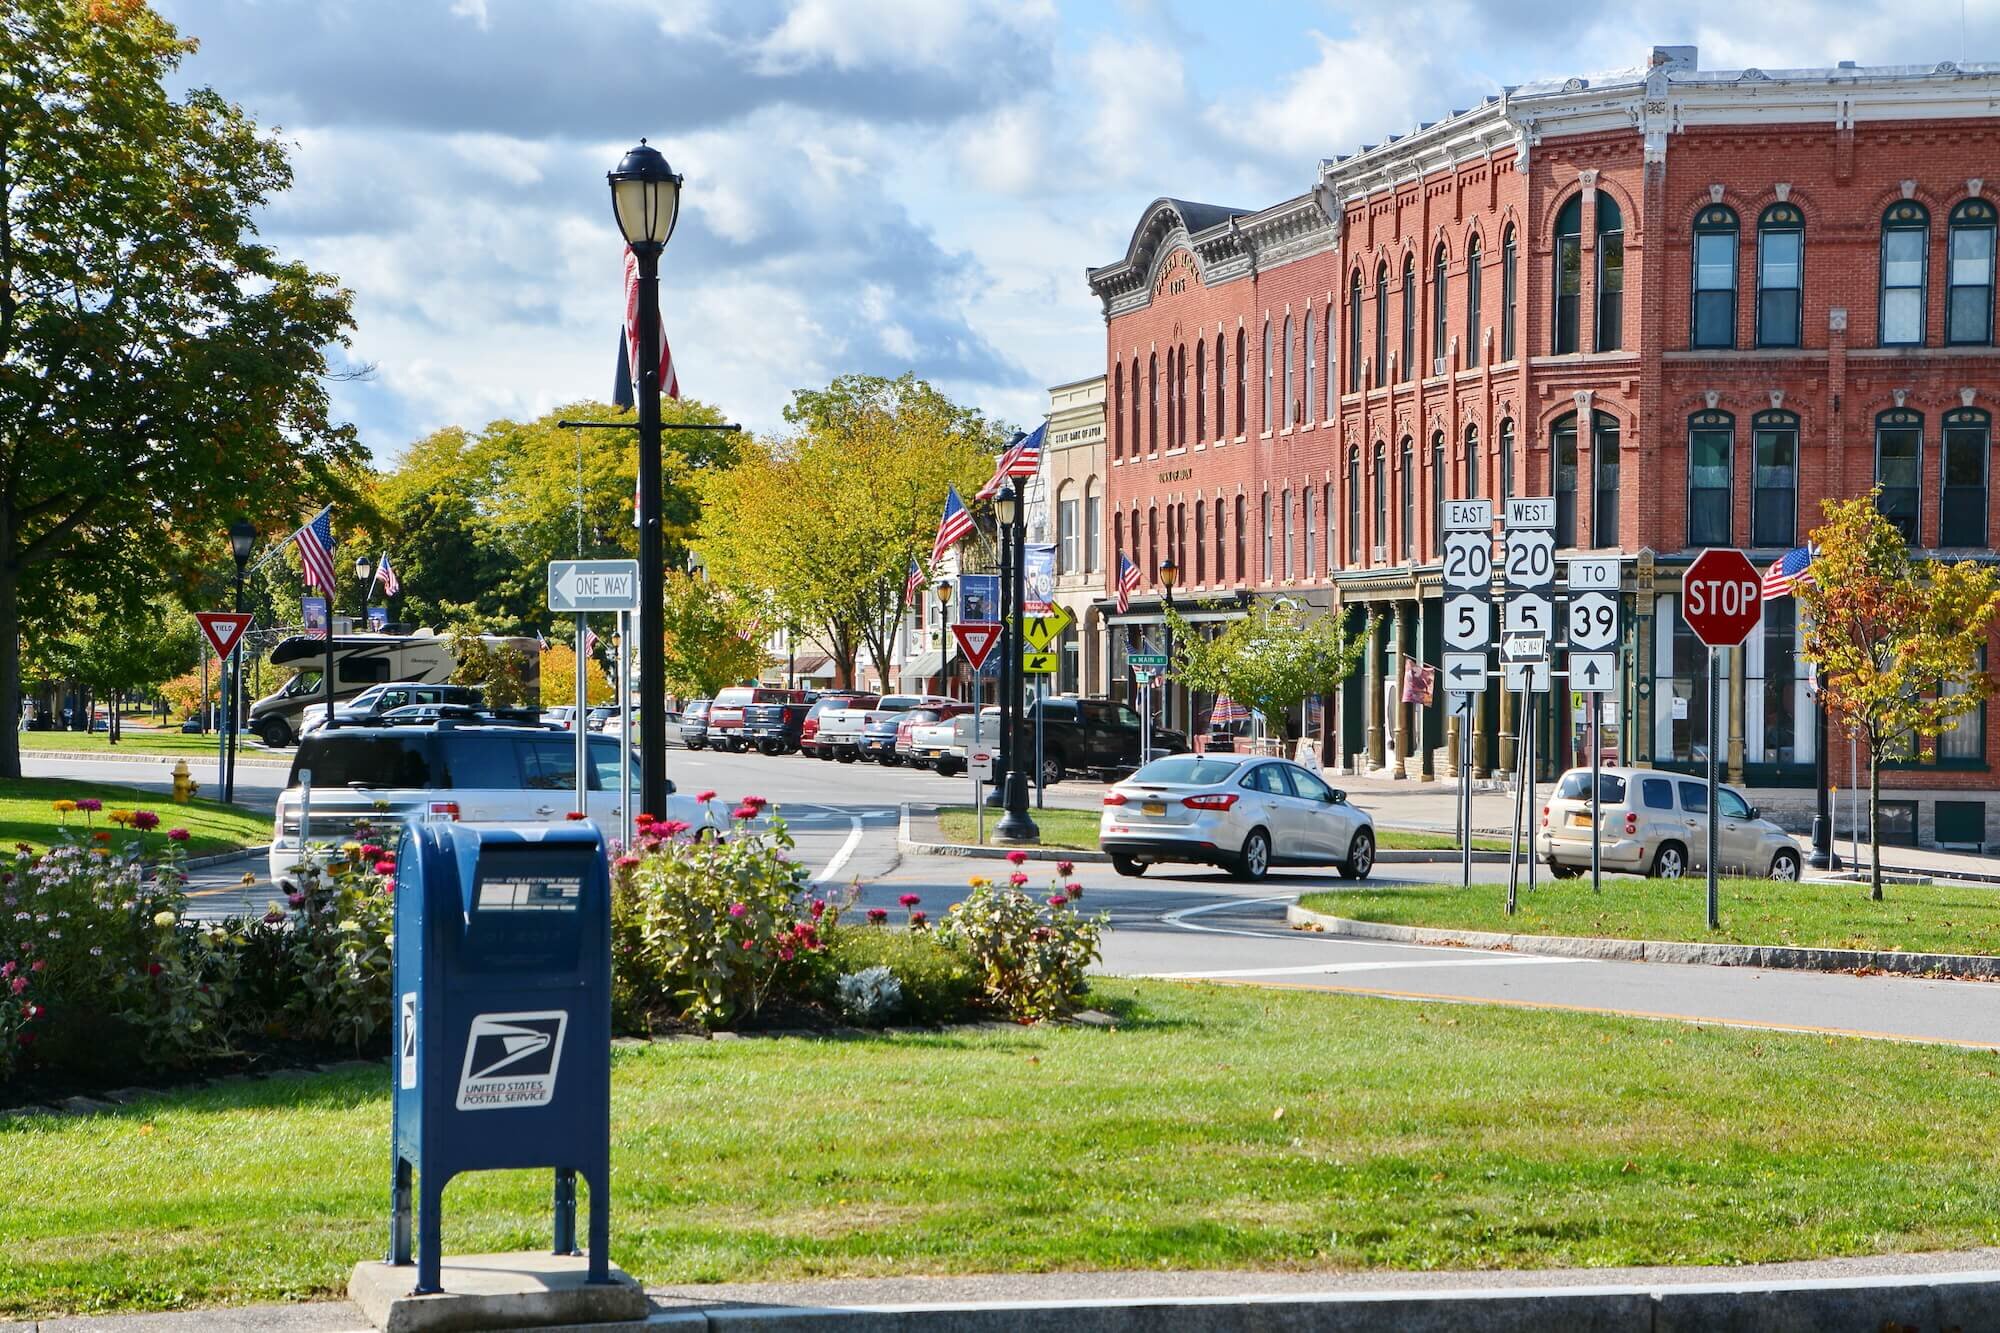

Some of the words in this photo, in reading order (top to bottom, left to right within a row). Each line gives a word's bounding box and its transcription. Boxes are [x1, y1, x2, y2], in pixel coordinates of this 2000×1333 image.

[1056, 433, 1069, 443] STATE
[1070, 430, 1081, 441] BANK
[1453, 506, 1483, 523] EAST
[1514, 504, 1548, 521] WEST
[1449, 545, 1486, 577] 20
[1511, 544, 1549, 576] 20
[1582, 566, 1606, 583] TO
[576, 577, 600, 595] ONE
[604, 577, 628, 595] WAY
[1689, 580, 1758, 616] STOP
[1458, 607, 1475, 638] 5
[1574, 606, 1614, 638] 39
[969, 635, 985, 643] YIELD
[1513, 640, 1526, 654] ONE
[1528, 639, 1541, 653] WAY
[465, 1083, 506, 1094] UNITED
[507, 1080, 543, 1091] STATES
[463, 1094, 502, 1104] POSTAL
[504, 1090, 546, 1103] SERVICE
